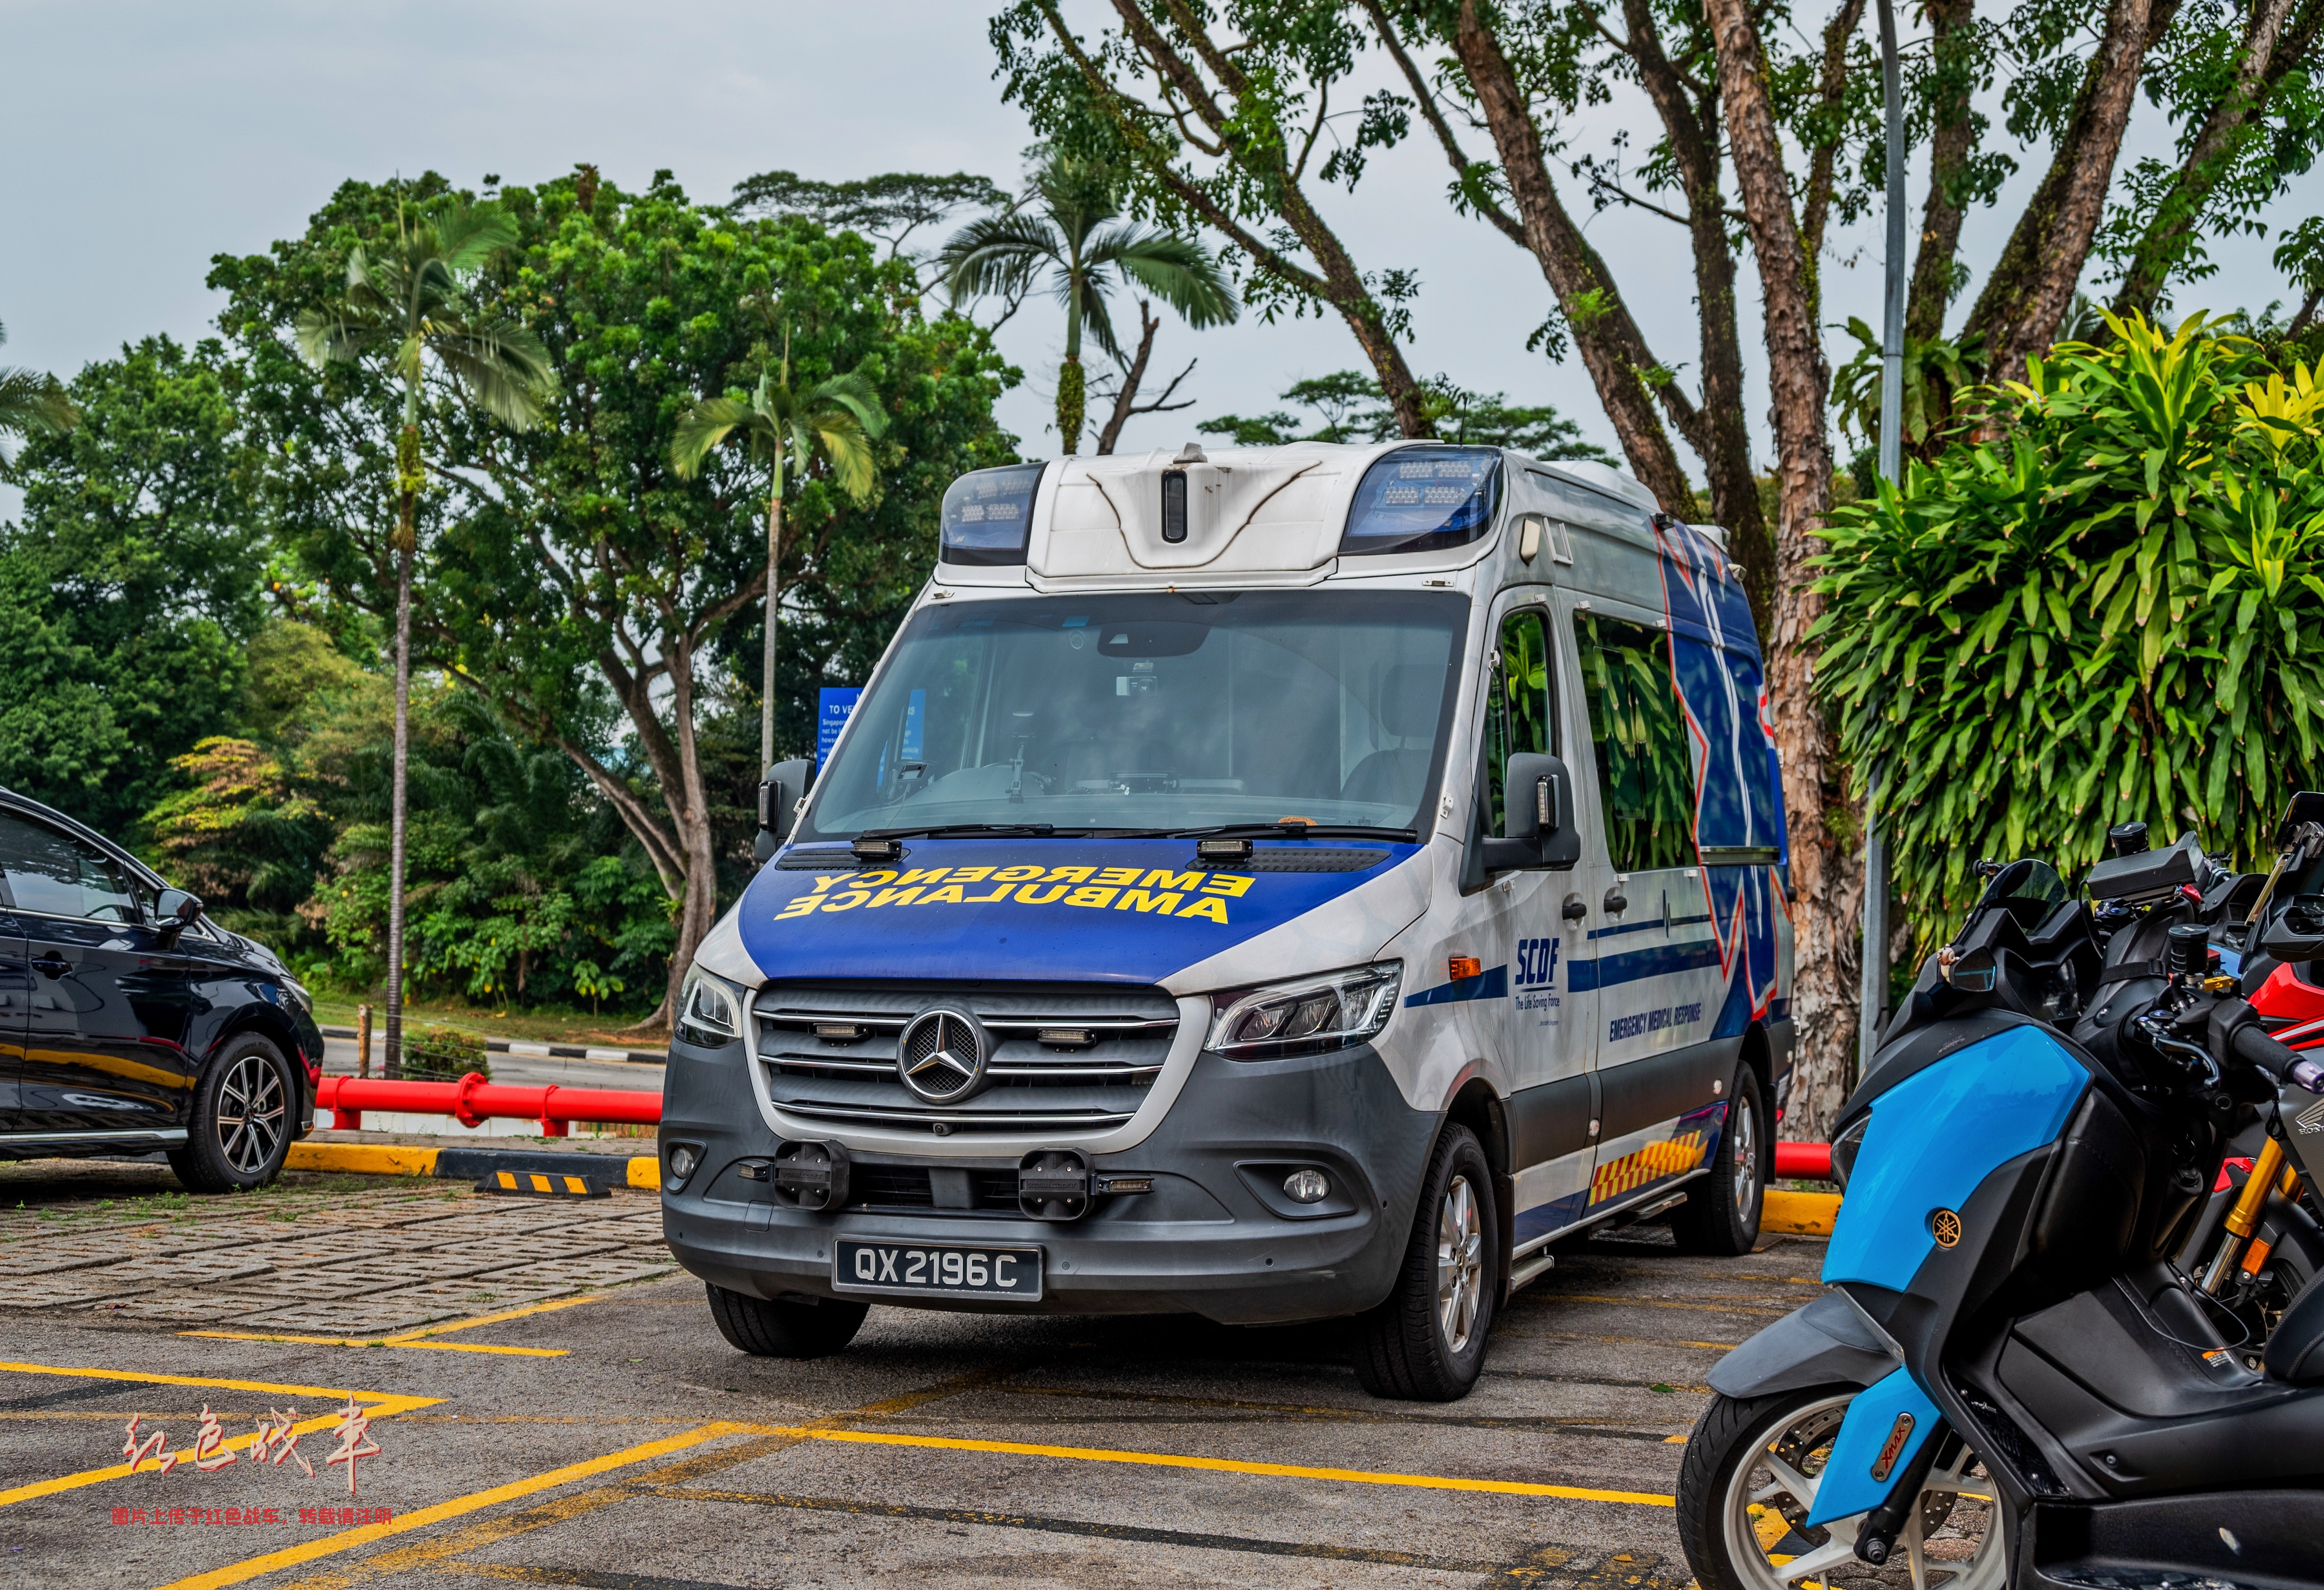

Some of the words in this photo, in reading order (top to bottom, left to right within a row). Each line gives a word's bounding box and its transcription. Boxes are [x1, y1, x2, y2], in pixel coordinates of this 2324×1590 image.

[829, 705, 840, 714] TO
[1515, 938, 1560, 985] SCDF
[1533, 994, 1547, 1011] Saving
[1548, 993, 1560, 1007] Force
[1609, 1013, 1648, 1042] EMERGENCY
[1648, 1007, 1672, 1033] MEDICAL
[1674, 1002, 1702, 1026] RESPONSE
